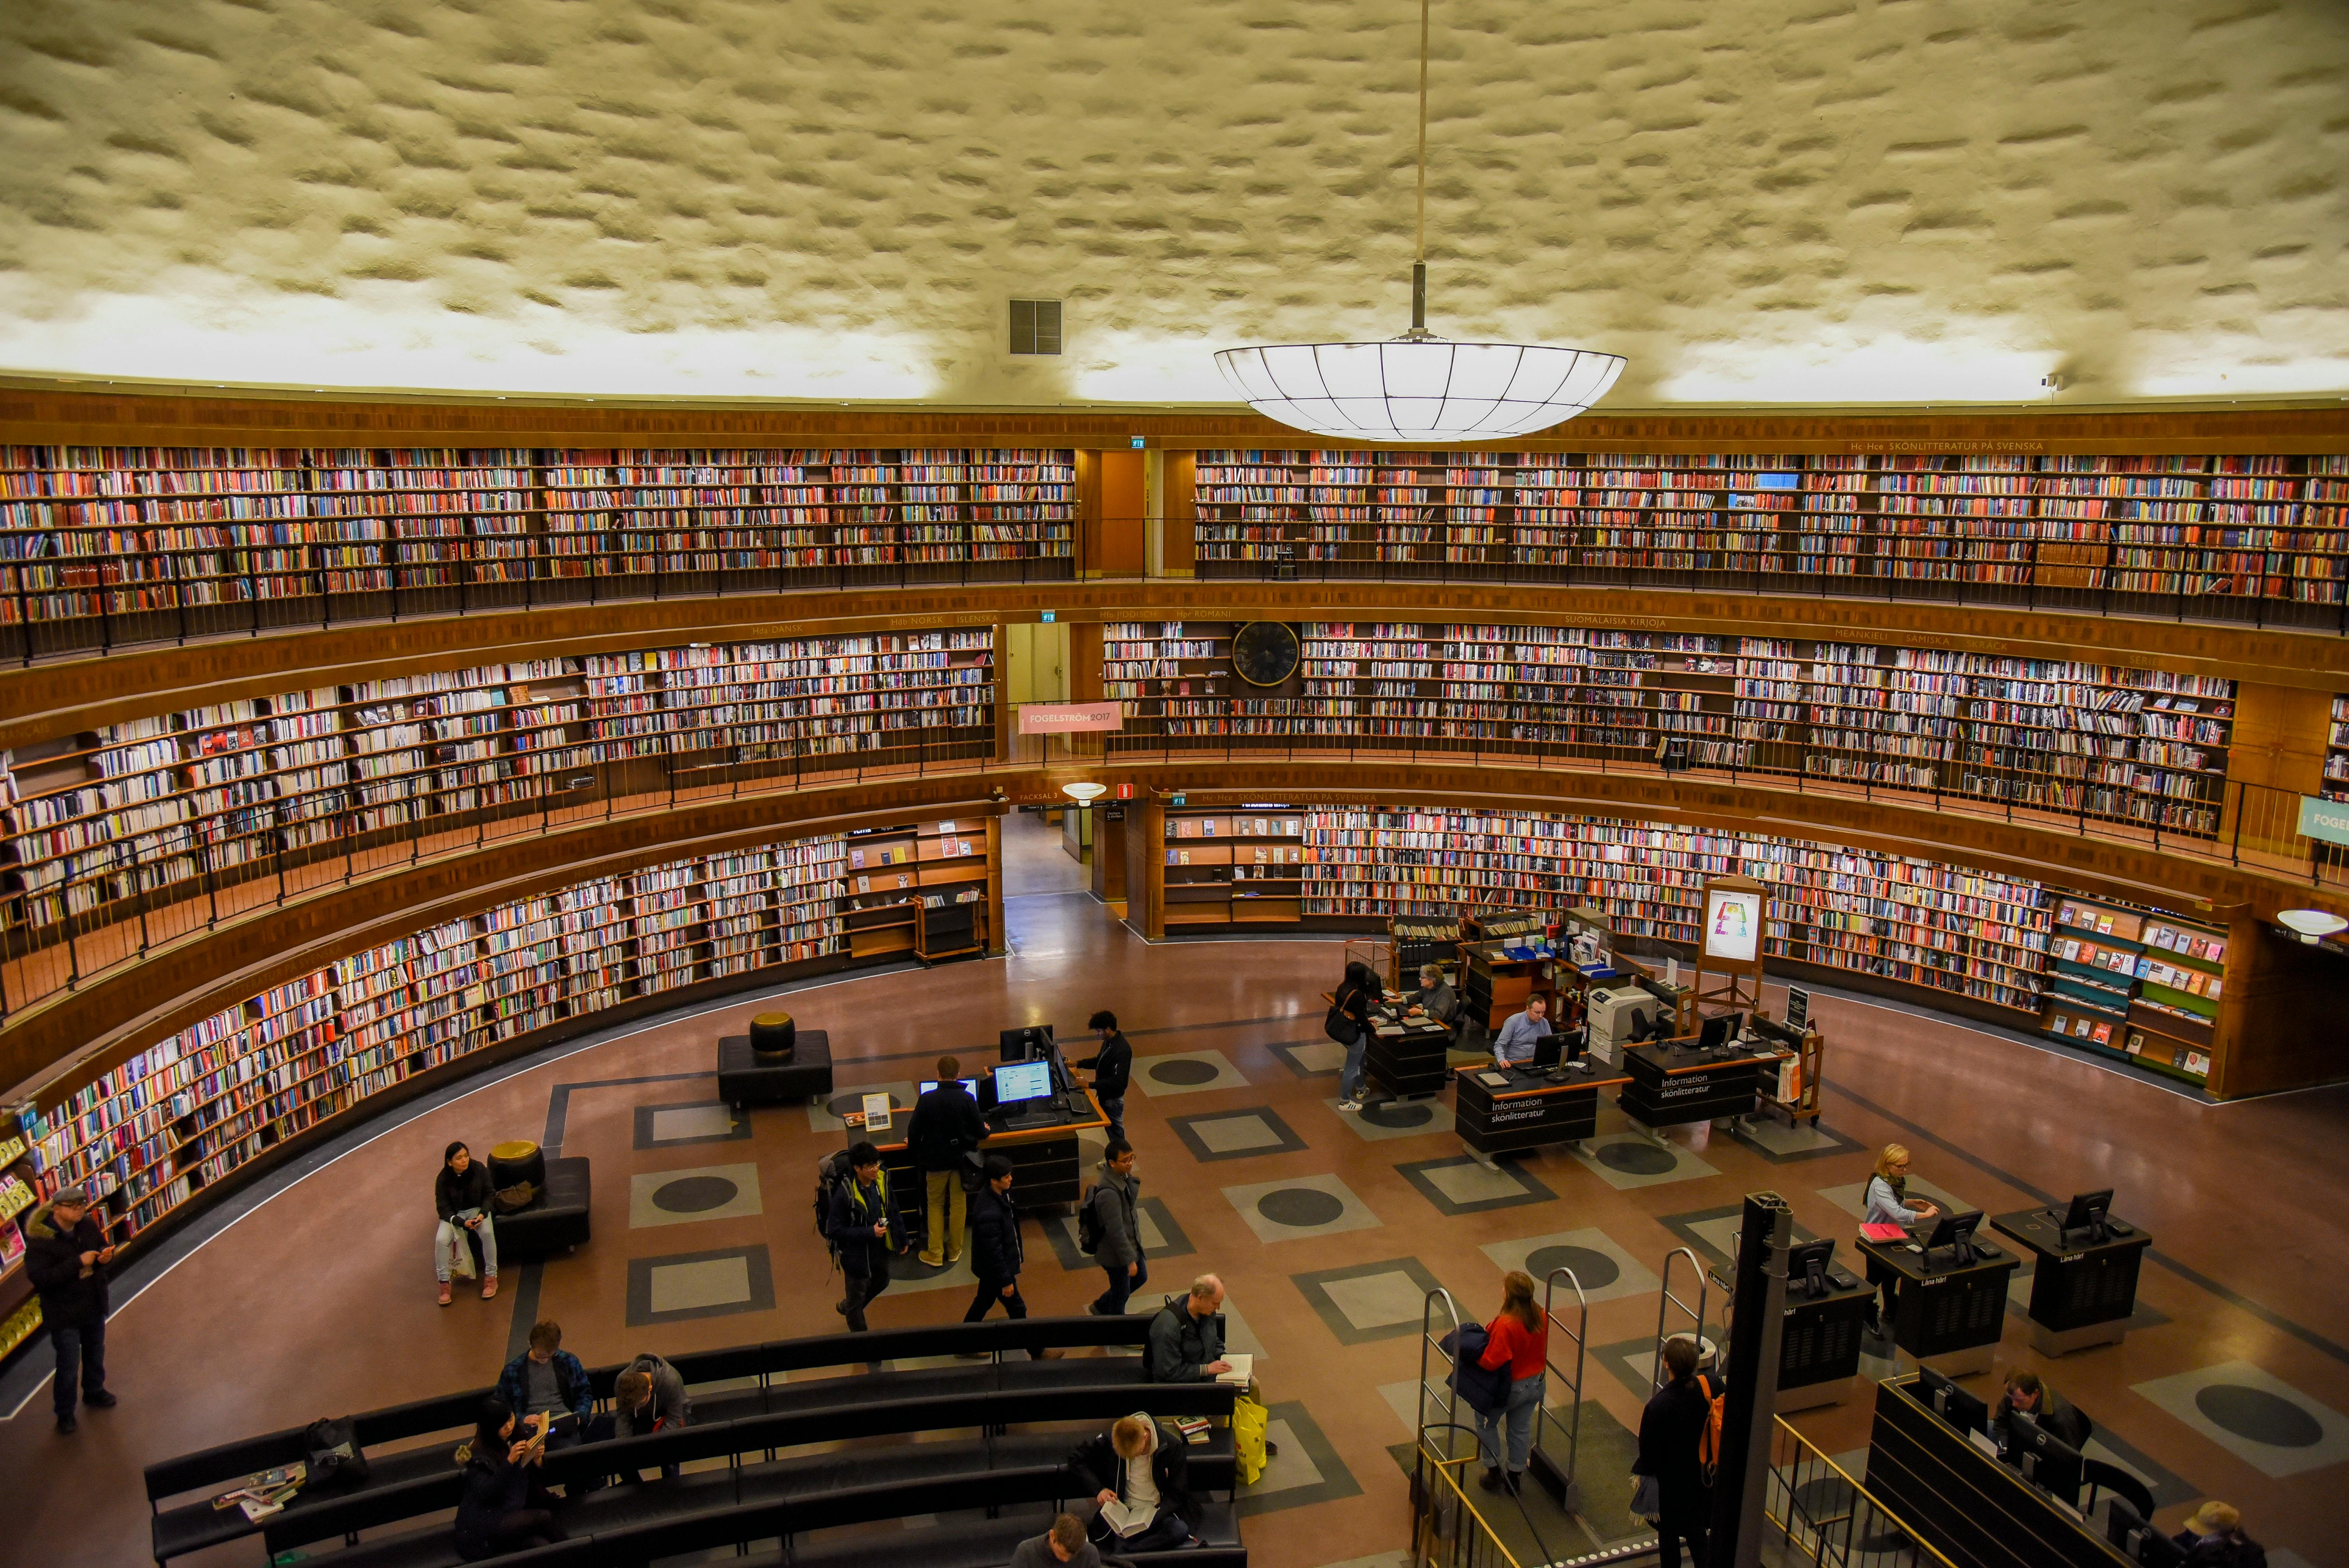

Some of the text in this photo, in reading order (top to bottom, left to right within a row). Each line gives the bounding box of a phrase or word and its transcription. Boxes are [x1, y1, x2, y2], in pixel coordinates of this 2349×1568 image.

[1889, 441, 1978, 450] SKÖNLITTERATUR
[1981, 441, 1993, 450] PÅ
[1996, 442, 2043, 450] SVENSKA
[911, 616, 943, 625] NORSK
[1117, 611, 1157, 620] JIDDISCH
[1565, 615, 1666, 628] SUOMALAISIA KIRJOJA
[772, 624, 803, 634] DANSK
[1836, 629, 1887, 640] MEANKIELI
[1906, 634, 1950, 645] SAMISKA
[1239, 793, 1318, 801] SKÖNLITTERATUR
[1322, 792, 1332, 801] PÅ
[299, 944, 343, 969] SVENSKA
[1662, 1075, 1708, 1087] Information
[1661, 1085, 1710, 1098] skönlitteratur
[1492, 1099, 1542, 1111] Information
[1492, 1109, 1545, 1123] skönlitteratur
[1710, 1272, 1729, 1292] Låna här!
[1936, 1276, 1946, 1285] här!
